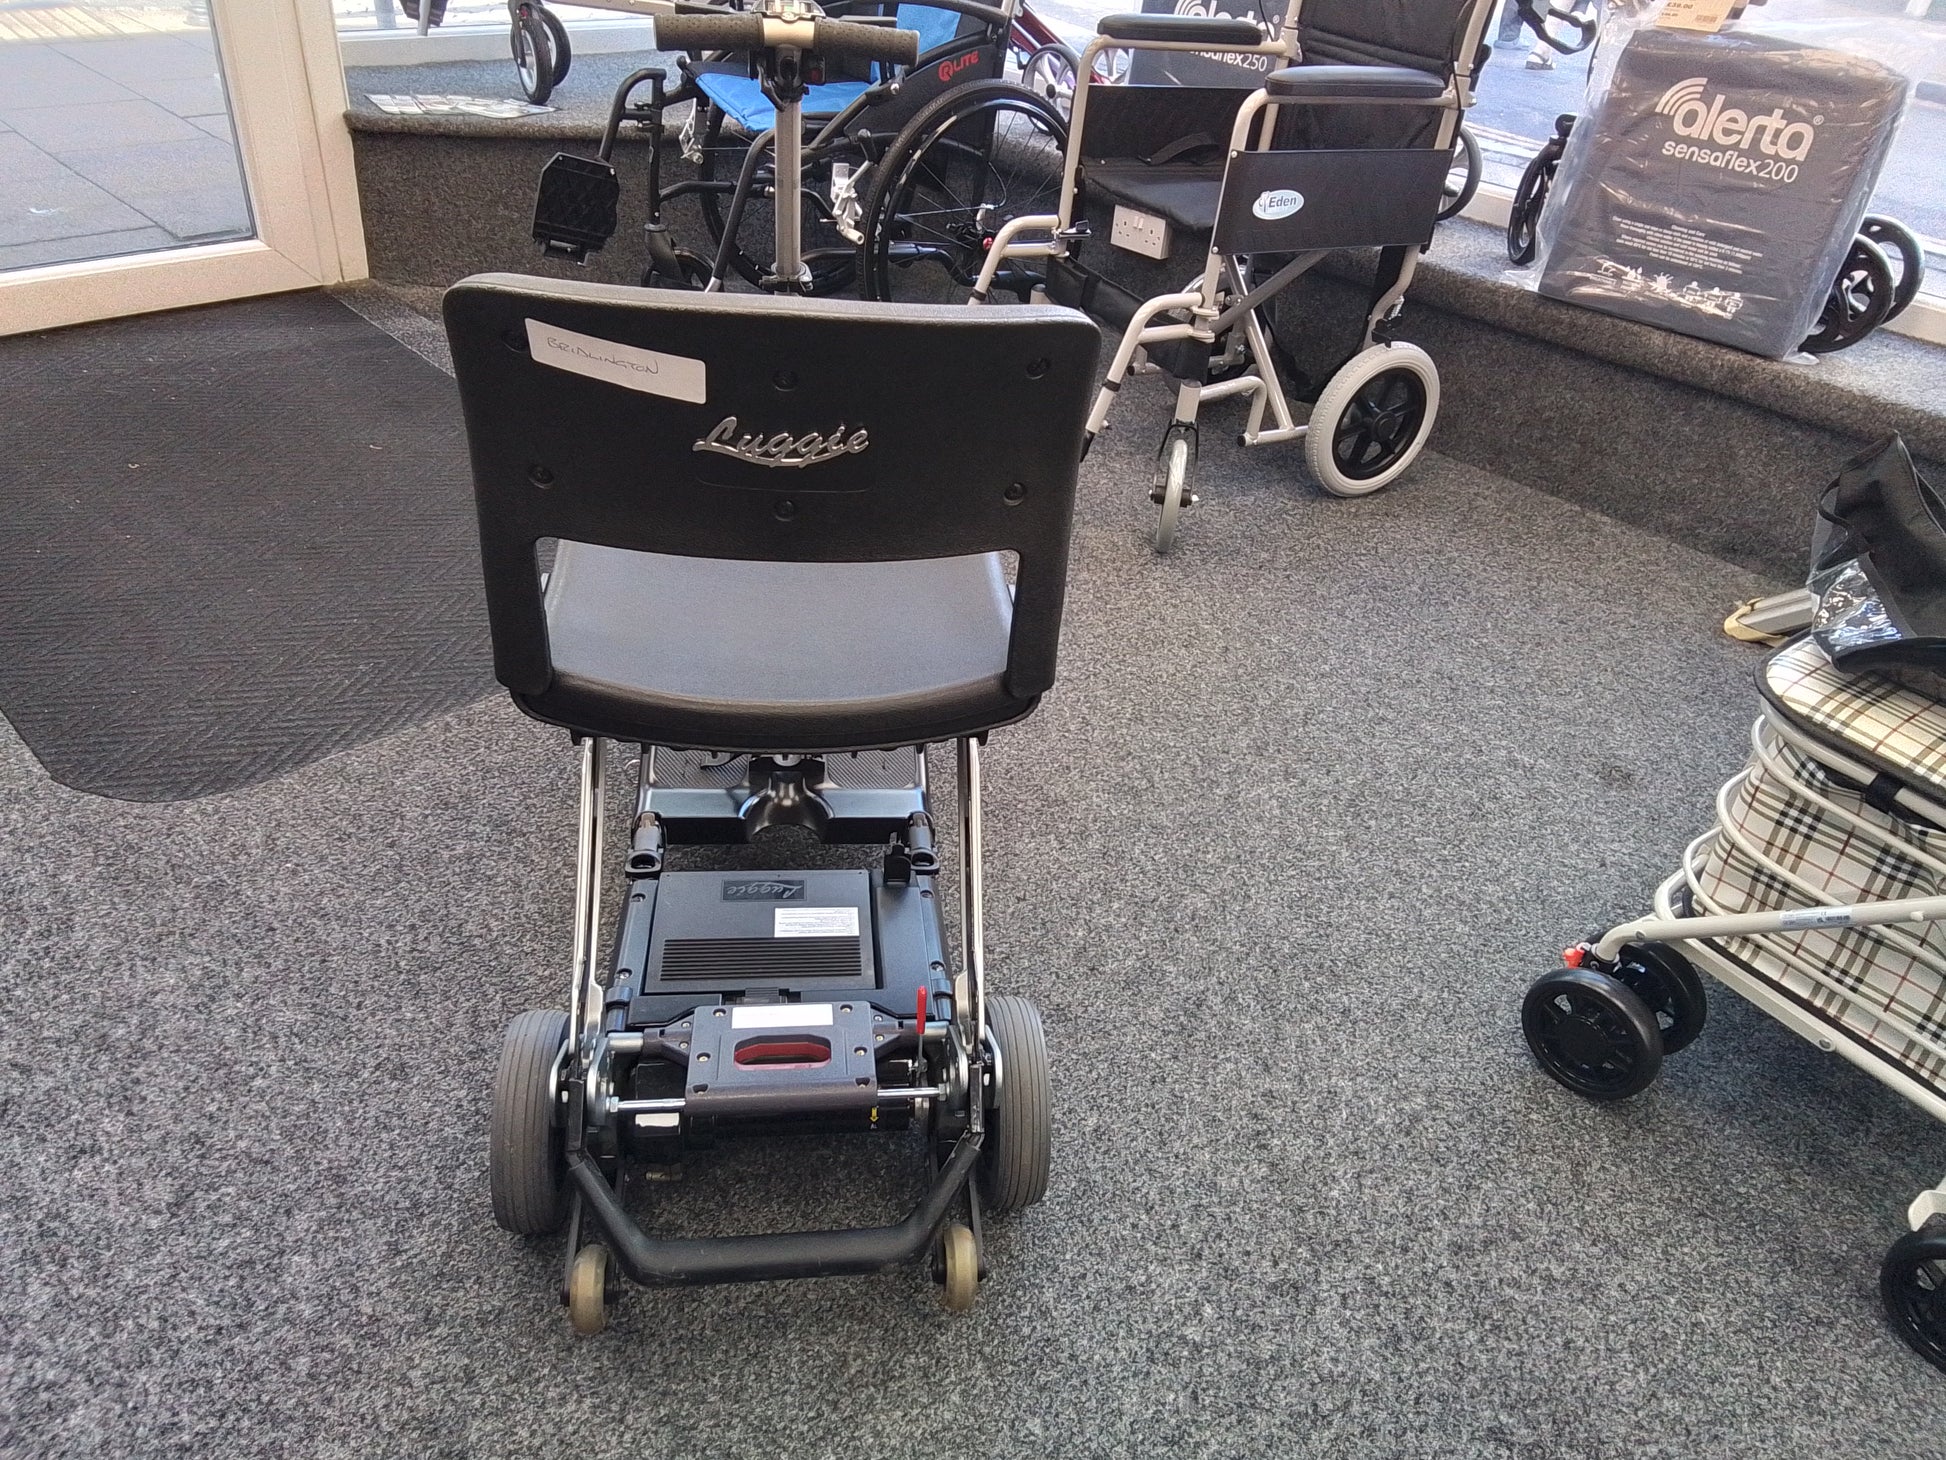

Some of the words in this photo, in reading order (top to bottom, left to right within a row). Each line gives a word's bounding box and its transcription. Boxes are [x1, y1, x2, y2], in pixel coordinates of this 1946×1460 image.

[1673, 94, 1815, 162] alerta
[1661, 140, 1799, 183] sensaflex200
[1268, 196, 1297, 208] Eden
[547, 337, 659, 375] BRIDLINGTON
[692, 416, 870, 468] Luggie
[727, 881, 803, 899] Luggie
